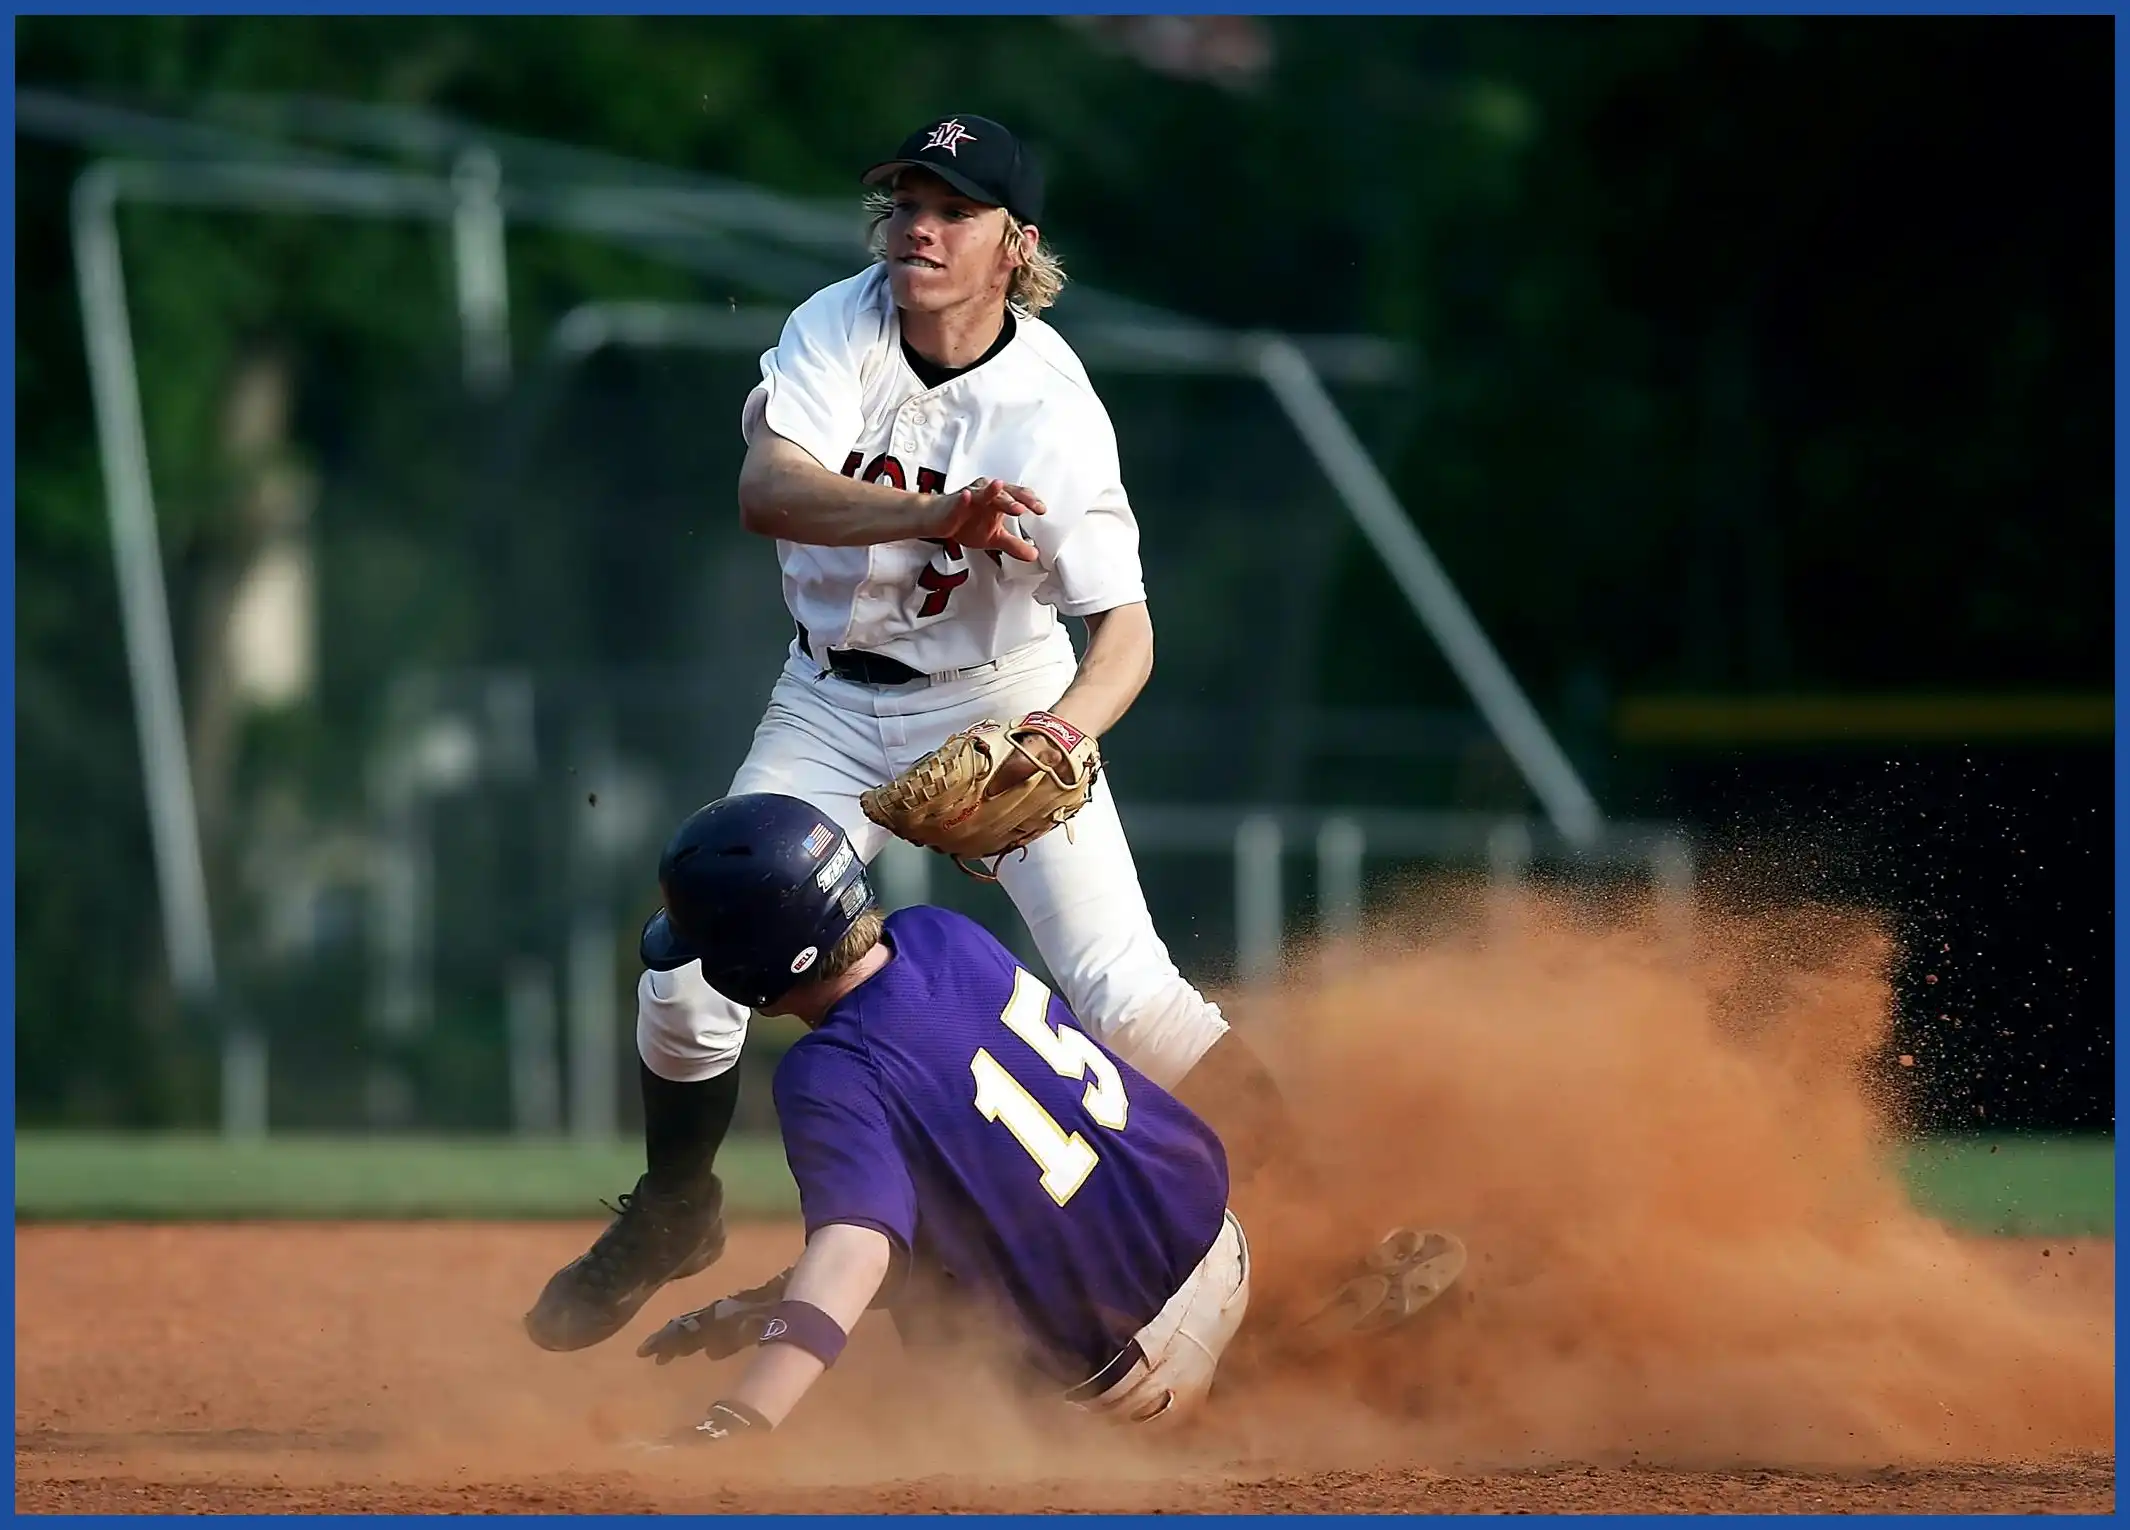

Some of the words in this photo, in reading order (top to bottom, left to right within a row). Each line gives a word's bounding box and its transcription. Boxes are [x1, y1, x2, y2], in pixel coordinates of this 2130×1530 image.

[929, 122, 966, 148] M
[793, 951, 816, 971] BELL
[970, 965, 1130, 1208] 15
